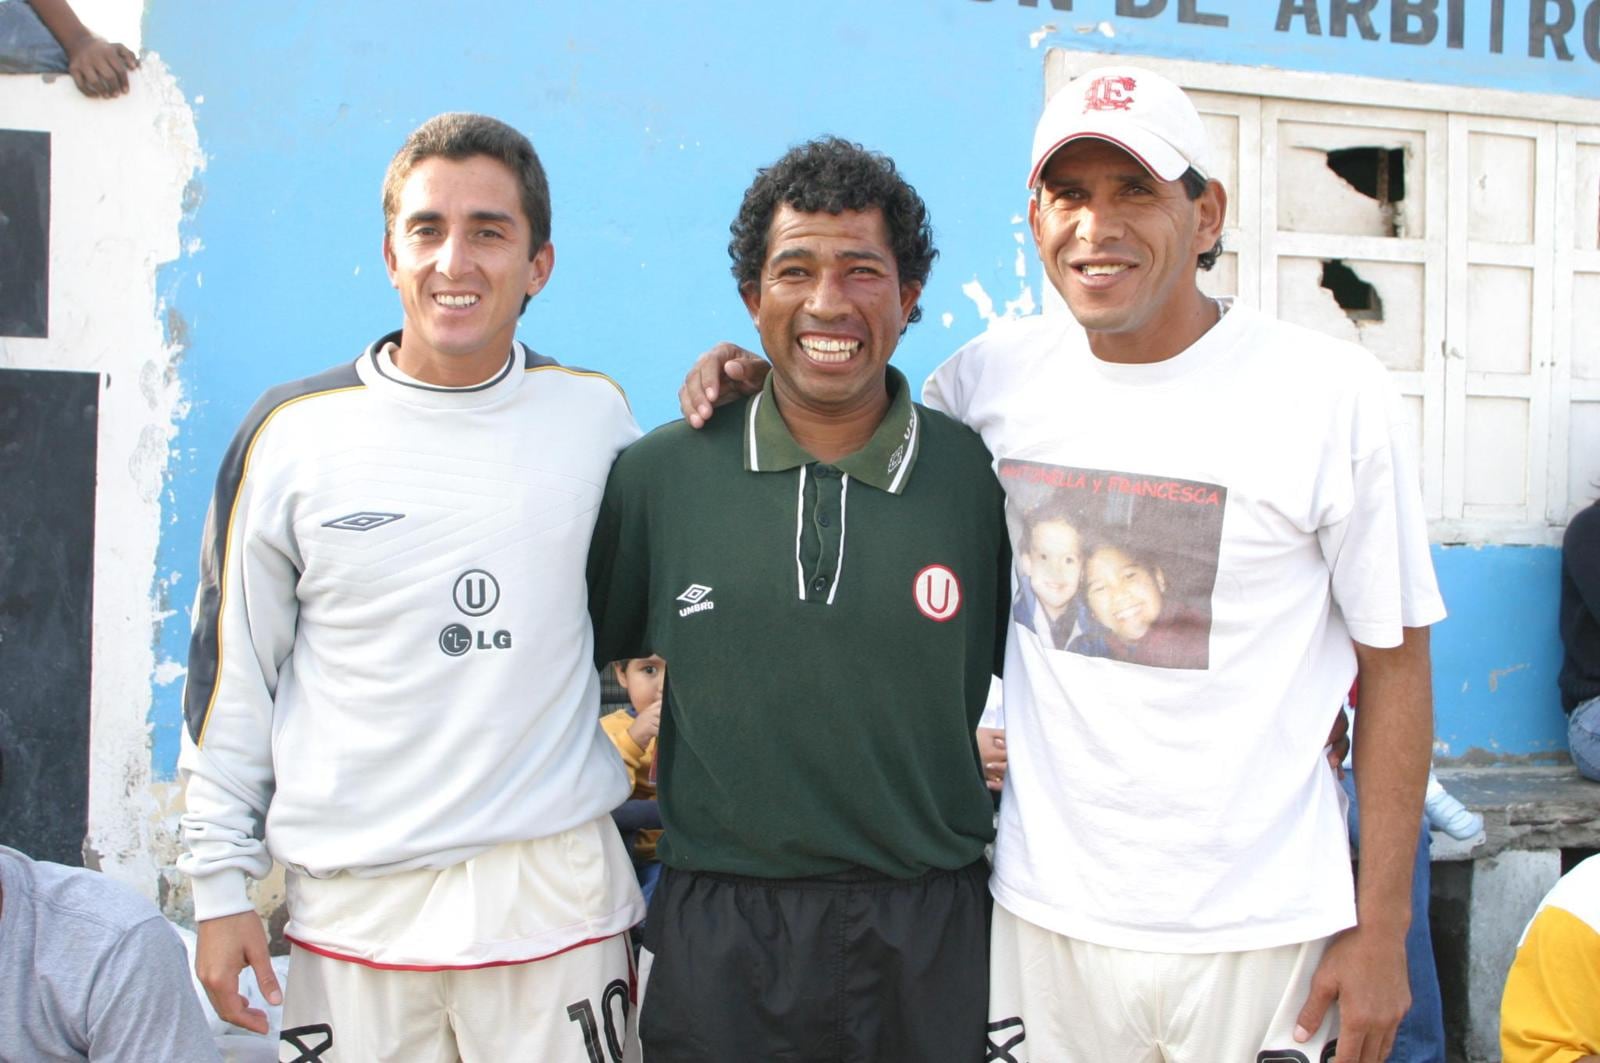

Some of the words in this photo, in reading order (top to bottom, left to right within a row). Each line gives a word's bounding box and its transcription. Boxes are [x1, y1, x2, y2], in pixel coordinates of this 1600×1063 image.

[1108, 476, 1219, 505] FRANCESCA
[466, 578, 486, 609] U
[679, 600, 714, 617] UMBRO
[927, 574, 950, 614] U
[477, 629, 512, 650] LG
[566, 979, 629, 1063] 10
